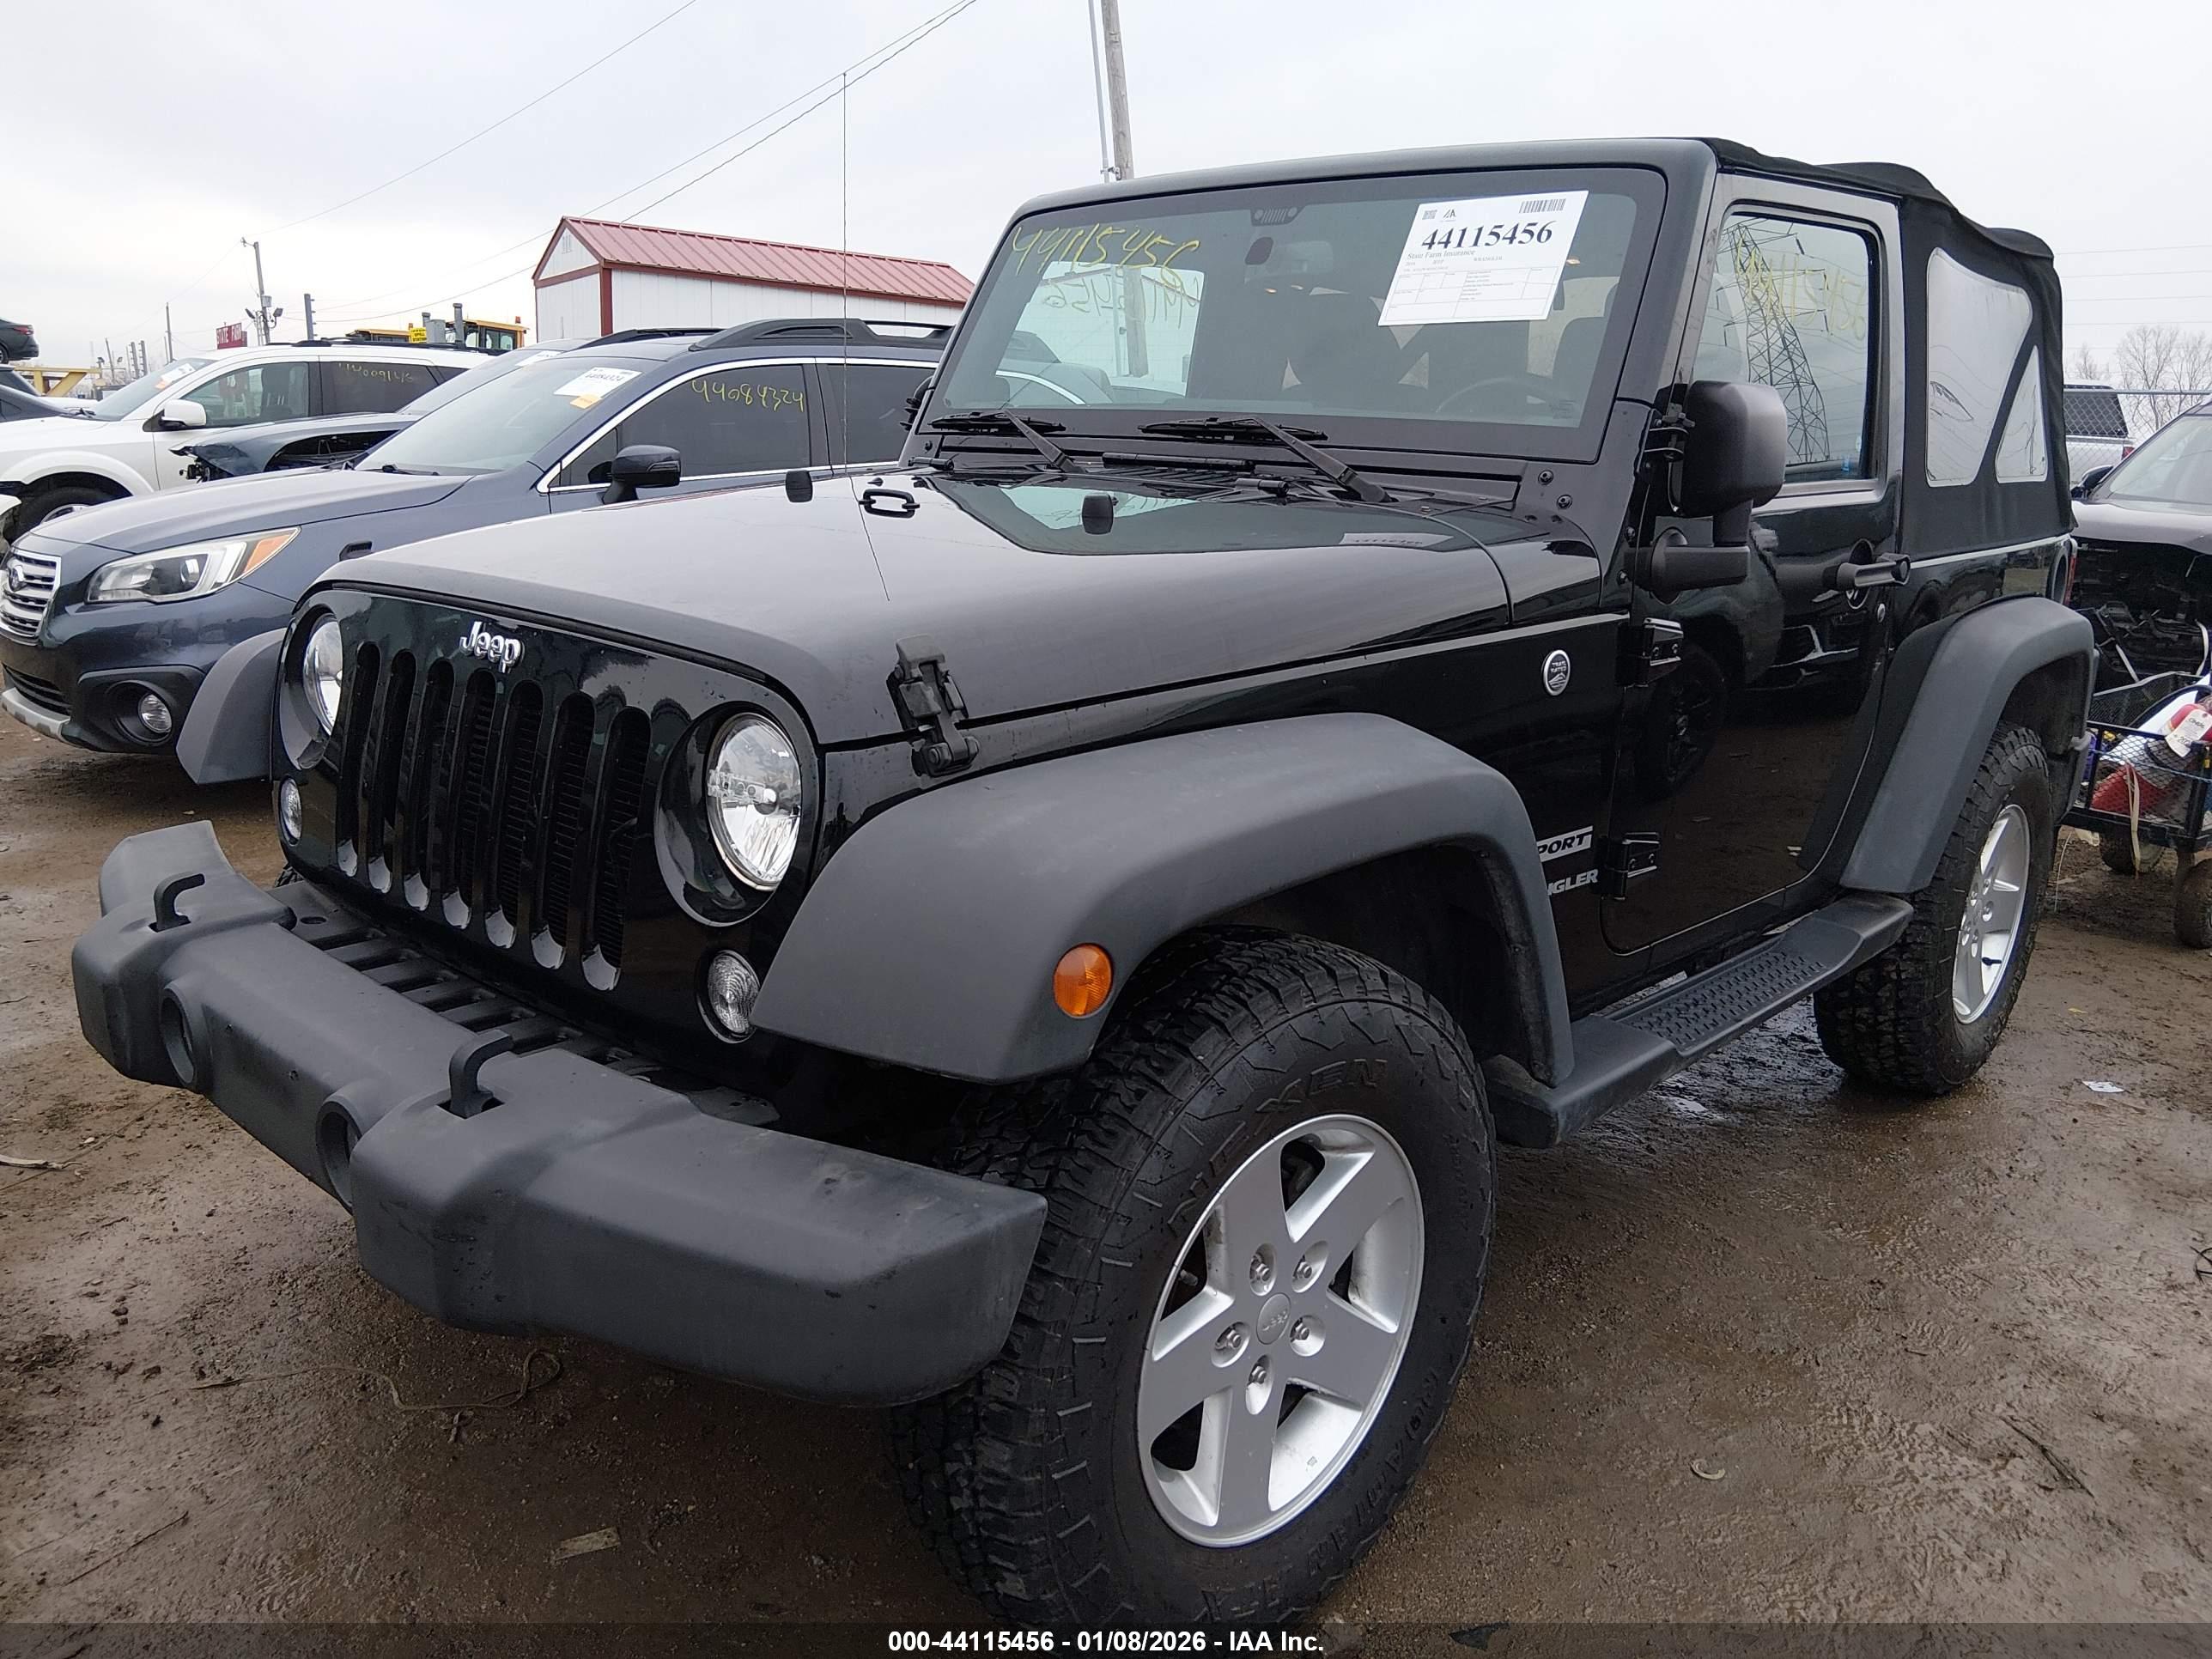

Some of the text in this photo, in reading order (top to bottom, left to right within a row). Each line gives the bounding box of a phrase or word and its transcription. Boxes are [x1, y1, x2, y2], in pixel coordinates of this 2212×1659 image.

[1421, 220, 1557, 251] 44115456
[691, 380, 805, 413] 44084324
[459, 620, 523, 674] Jeep
[1537, 830, 1594, 854] PORT
